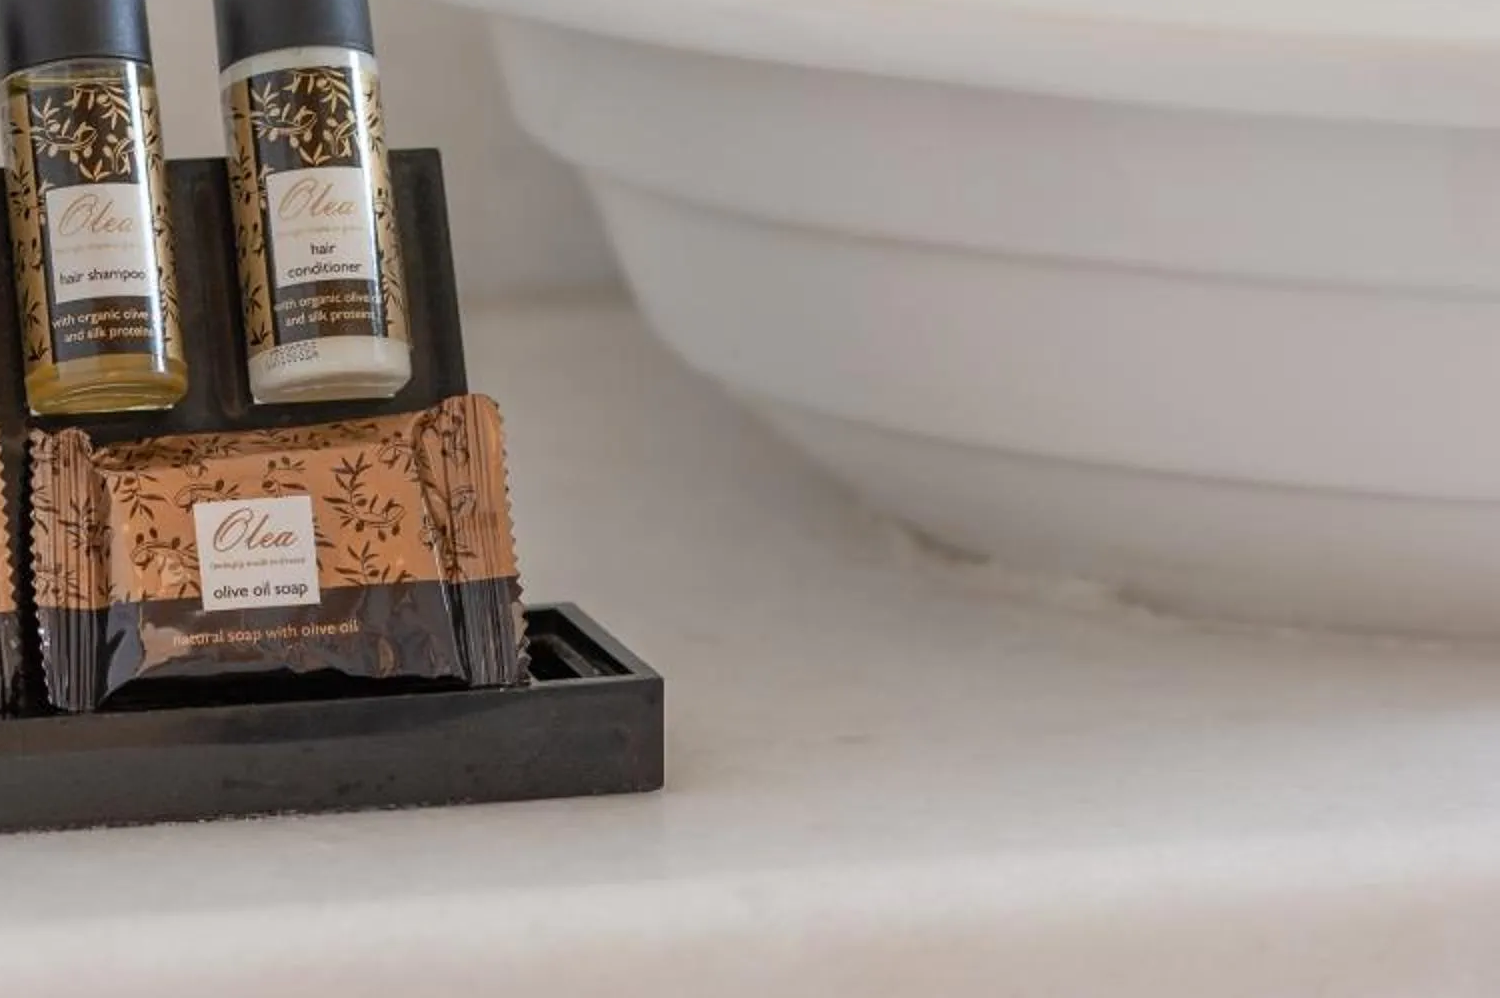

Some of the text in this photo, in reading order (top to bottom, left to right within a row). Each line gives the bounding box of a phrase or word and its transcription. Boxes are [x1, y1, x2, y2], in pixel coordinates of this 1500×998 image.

[277, 178, 355, 221] Olea
[58, 193, 133, 236] Olea
[310, 242, 336, 255] hair
[59, 266, 147, 286] hair shampoo
[287, 261, 363, 279] conditioner
[52, 314, 75, 329] with
[63, 331, 85, 343] and
[212, 506, 298, 552] Olea
[213, 581, 309, 600] olive oil soap
[173, 618, 359, 647] natural soap with olive oil
